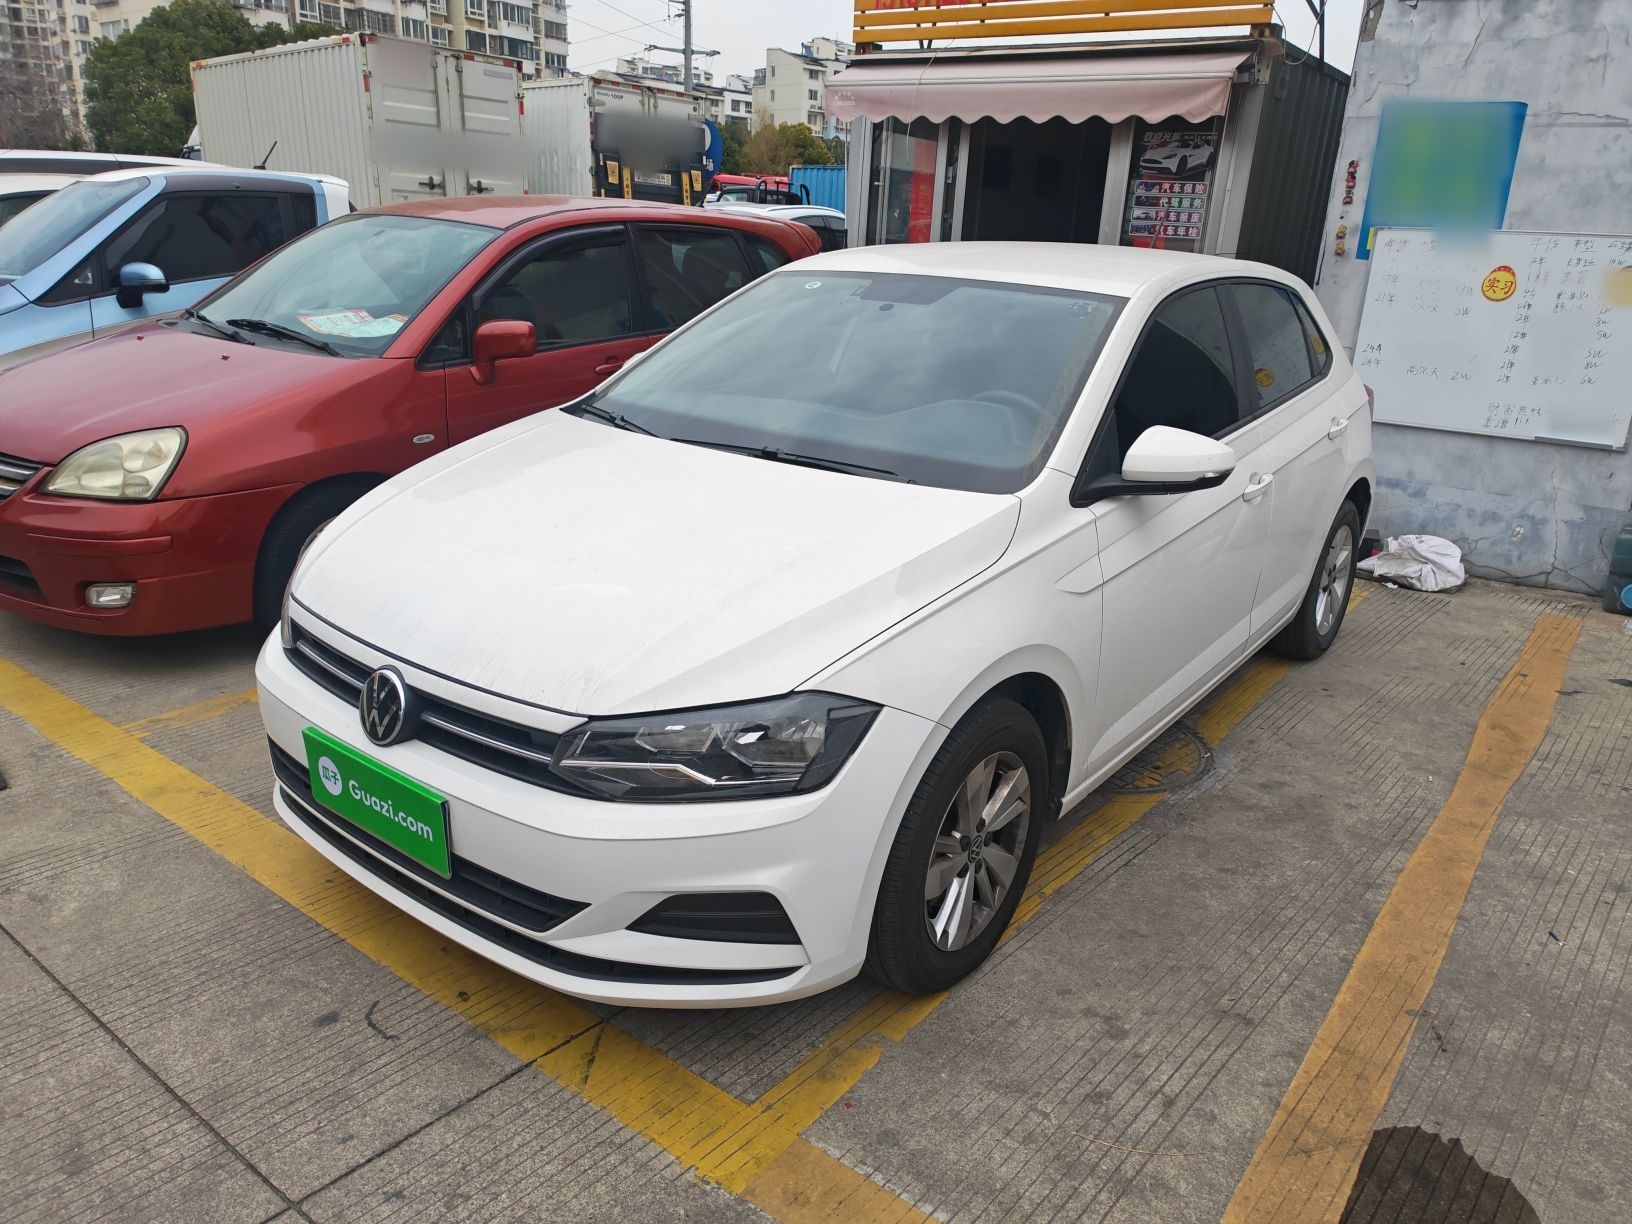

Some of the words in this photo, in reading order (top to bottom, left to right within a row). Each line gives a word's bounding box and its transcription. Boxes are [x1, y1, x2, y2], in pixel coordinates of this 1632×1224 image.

[1161, 182, 1205, 194] 汽车保险
[1160, 197, 1202, 208] 代驾服务
[1157, 211, 1200, 223] 汽车报废
[1155, 225, 1198, 237] 汽车年检
[1485, 277, 1513, 295] 实习
[321, 765, 340, 787] 瓜子
[348, 779, 434, 842] Guazi.com
